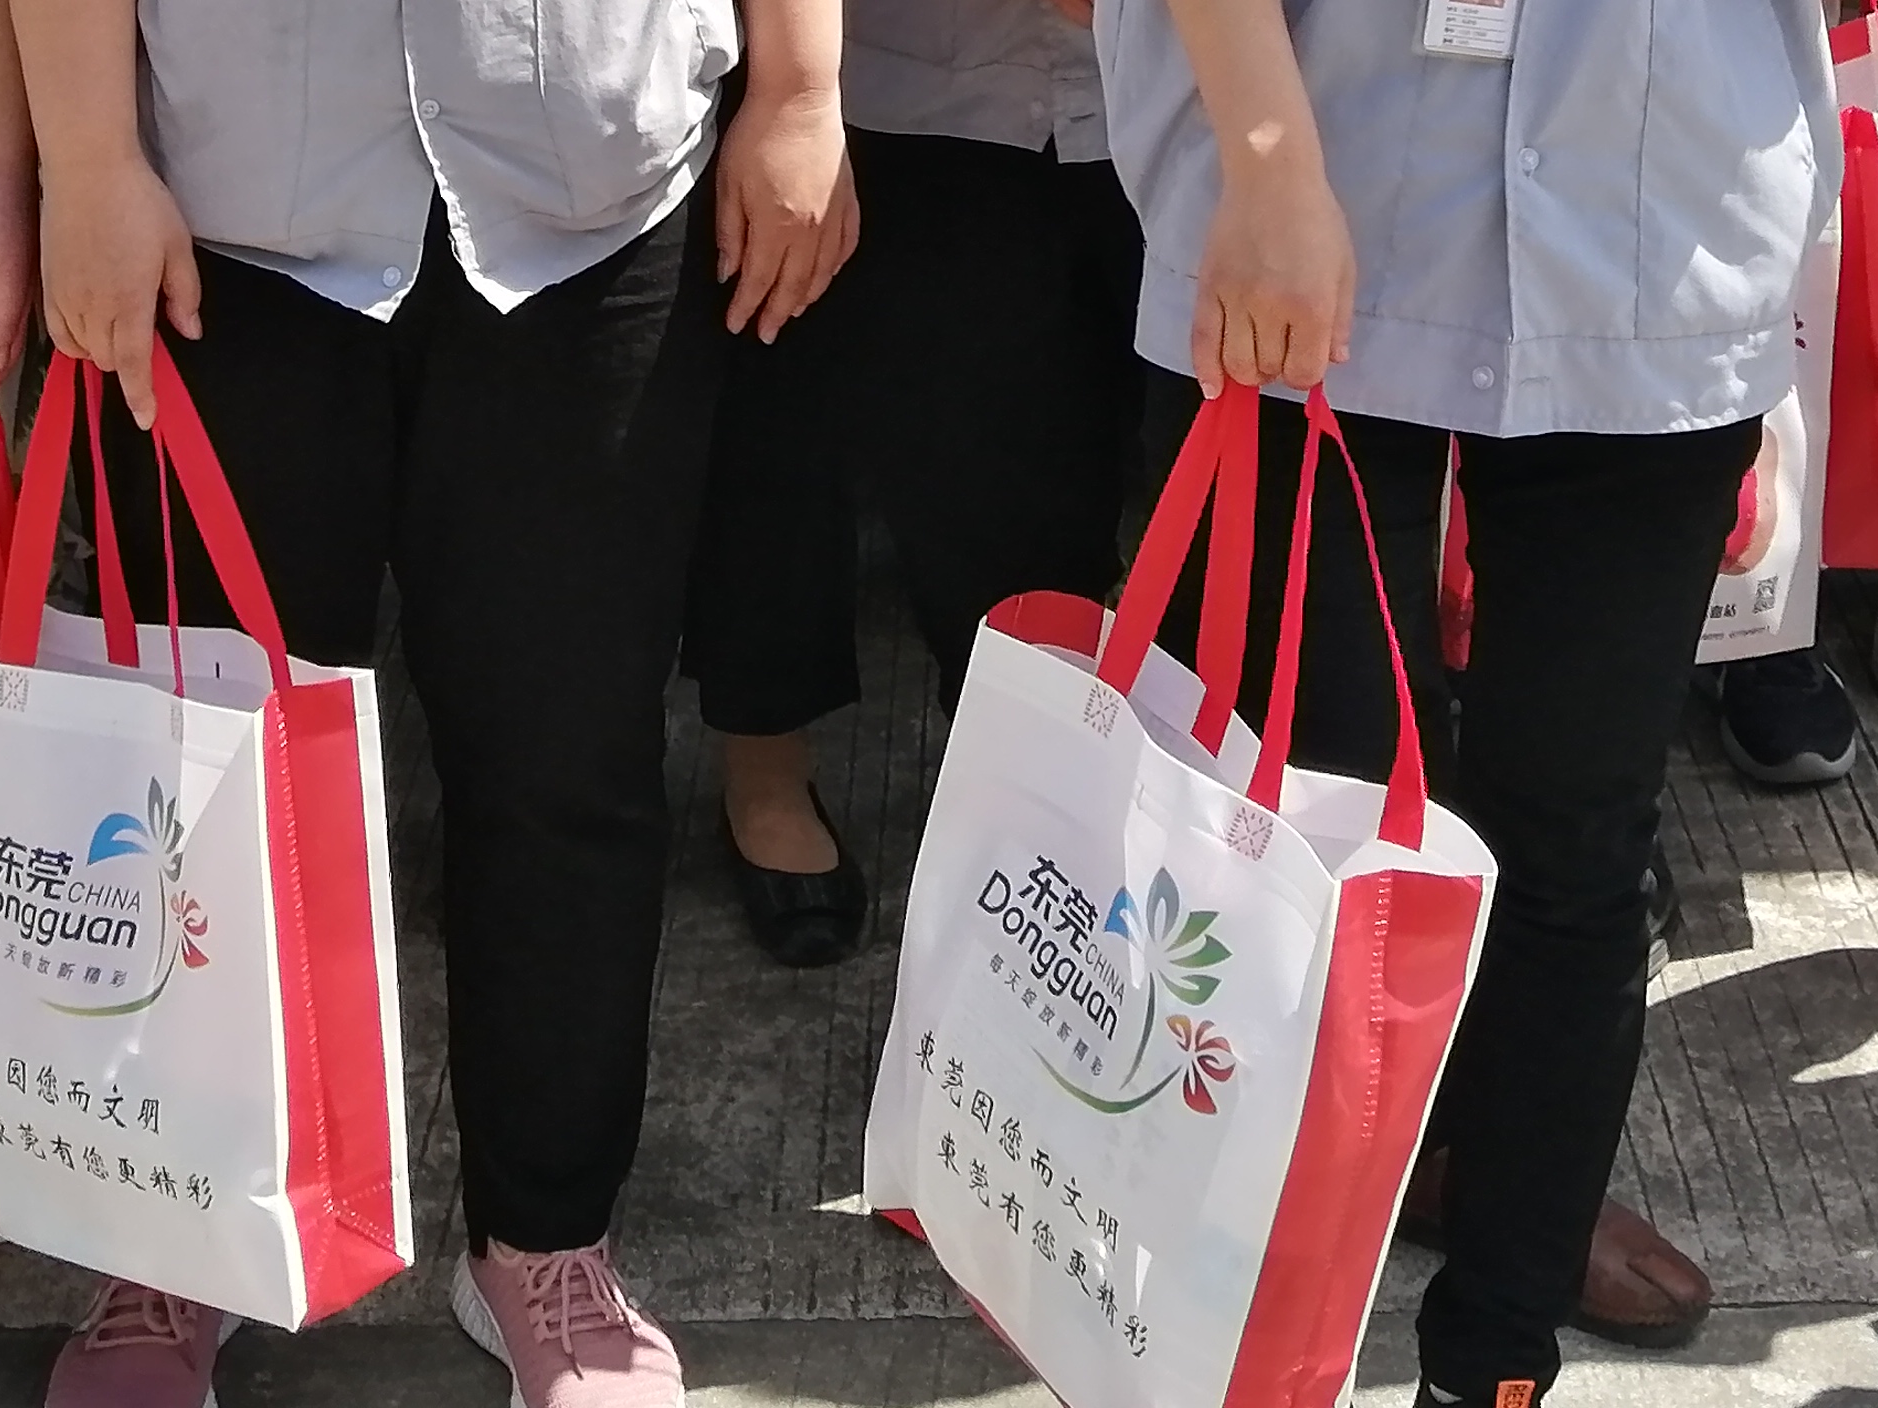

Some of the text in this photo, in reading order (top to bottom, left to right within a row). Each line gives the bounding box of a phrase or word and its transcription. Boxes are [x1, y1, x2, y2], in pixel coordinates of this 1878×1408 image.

[67, 881, 141, 913] CHINA
[977, 869, 1119, 1042] Dongguan
[1017, 854, 1126, 1007] 东莞 CHINA
